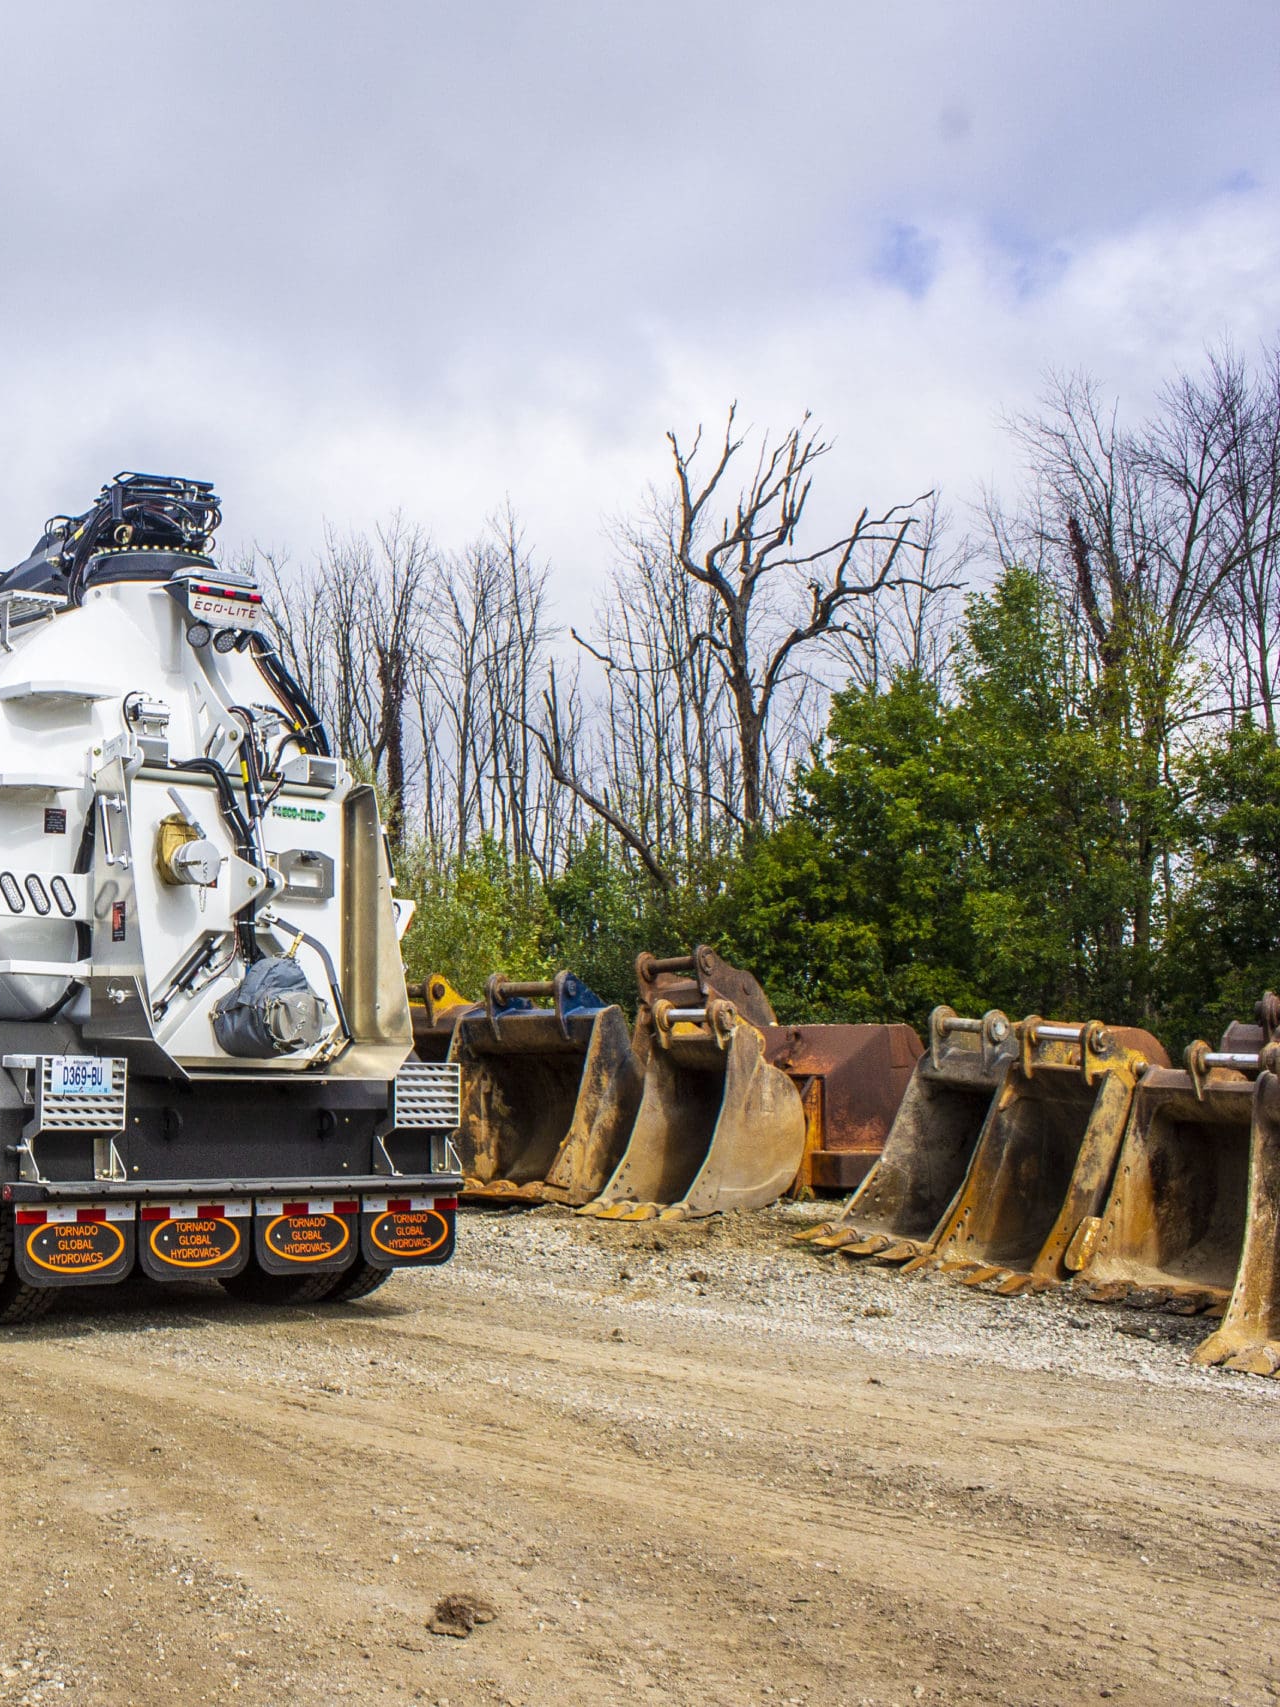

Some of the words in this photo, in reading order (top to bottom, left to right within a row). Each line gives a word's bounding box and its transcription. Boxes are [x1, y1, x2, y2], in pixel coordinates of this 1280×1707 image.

[194, 600, 257, 619] ECO-LITE
[63, 1066, 103, 1086] D369-BU
[288, 1218, 326, 1228] TORNADO
[392, 1213, 428, 1224] TORNADO
[54, 1226, 98, 1237] TORNADO
[175, 1222, 216, 1232] TORNADO
[396, 1226, 424, 1236] GLOBAL
[179, 1235, 212, 1245] GLOBAL
[291, 1231, 322, 1241] GLOBAL
[58, 1240, 94, 1250] GLOBAL
[284, 1242, 331, 1253] HYDROVACS
[388, 1238, 432, 1249] HYDROVACS
[171, 1247, 220, 1258] HYDROVACS
[49, 1253, 103, 1265] HYDROVACS
